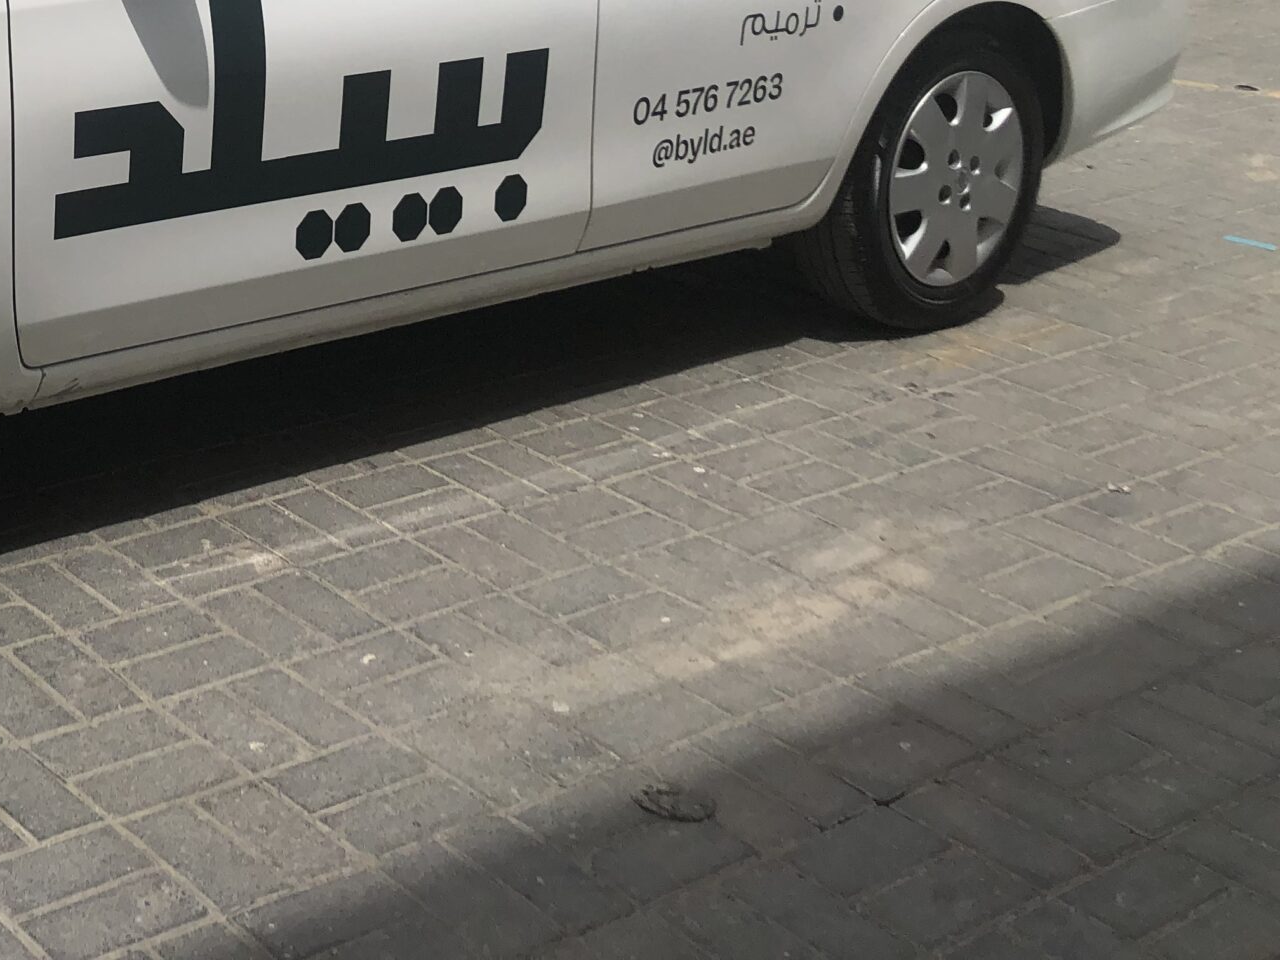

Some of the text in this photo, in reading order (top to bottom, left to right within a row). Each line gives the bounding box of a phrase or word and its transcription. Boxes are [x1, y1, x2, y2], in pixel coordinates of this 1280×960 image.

[633, 72, 784, 125] 04 576 7263
[652, 125, 756, 168] @byld.ae
